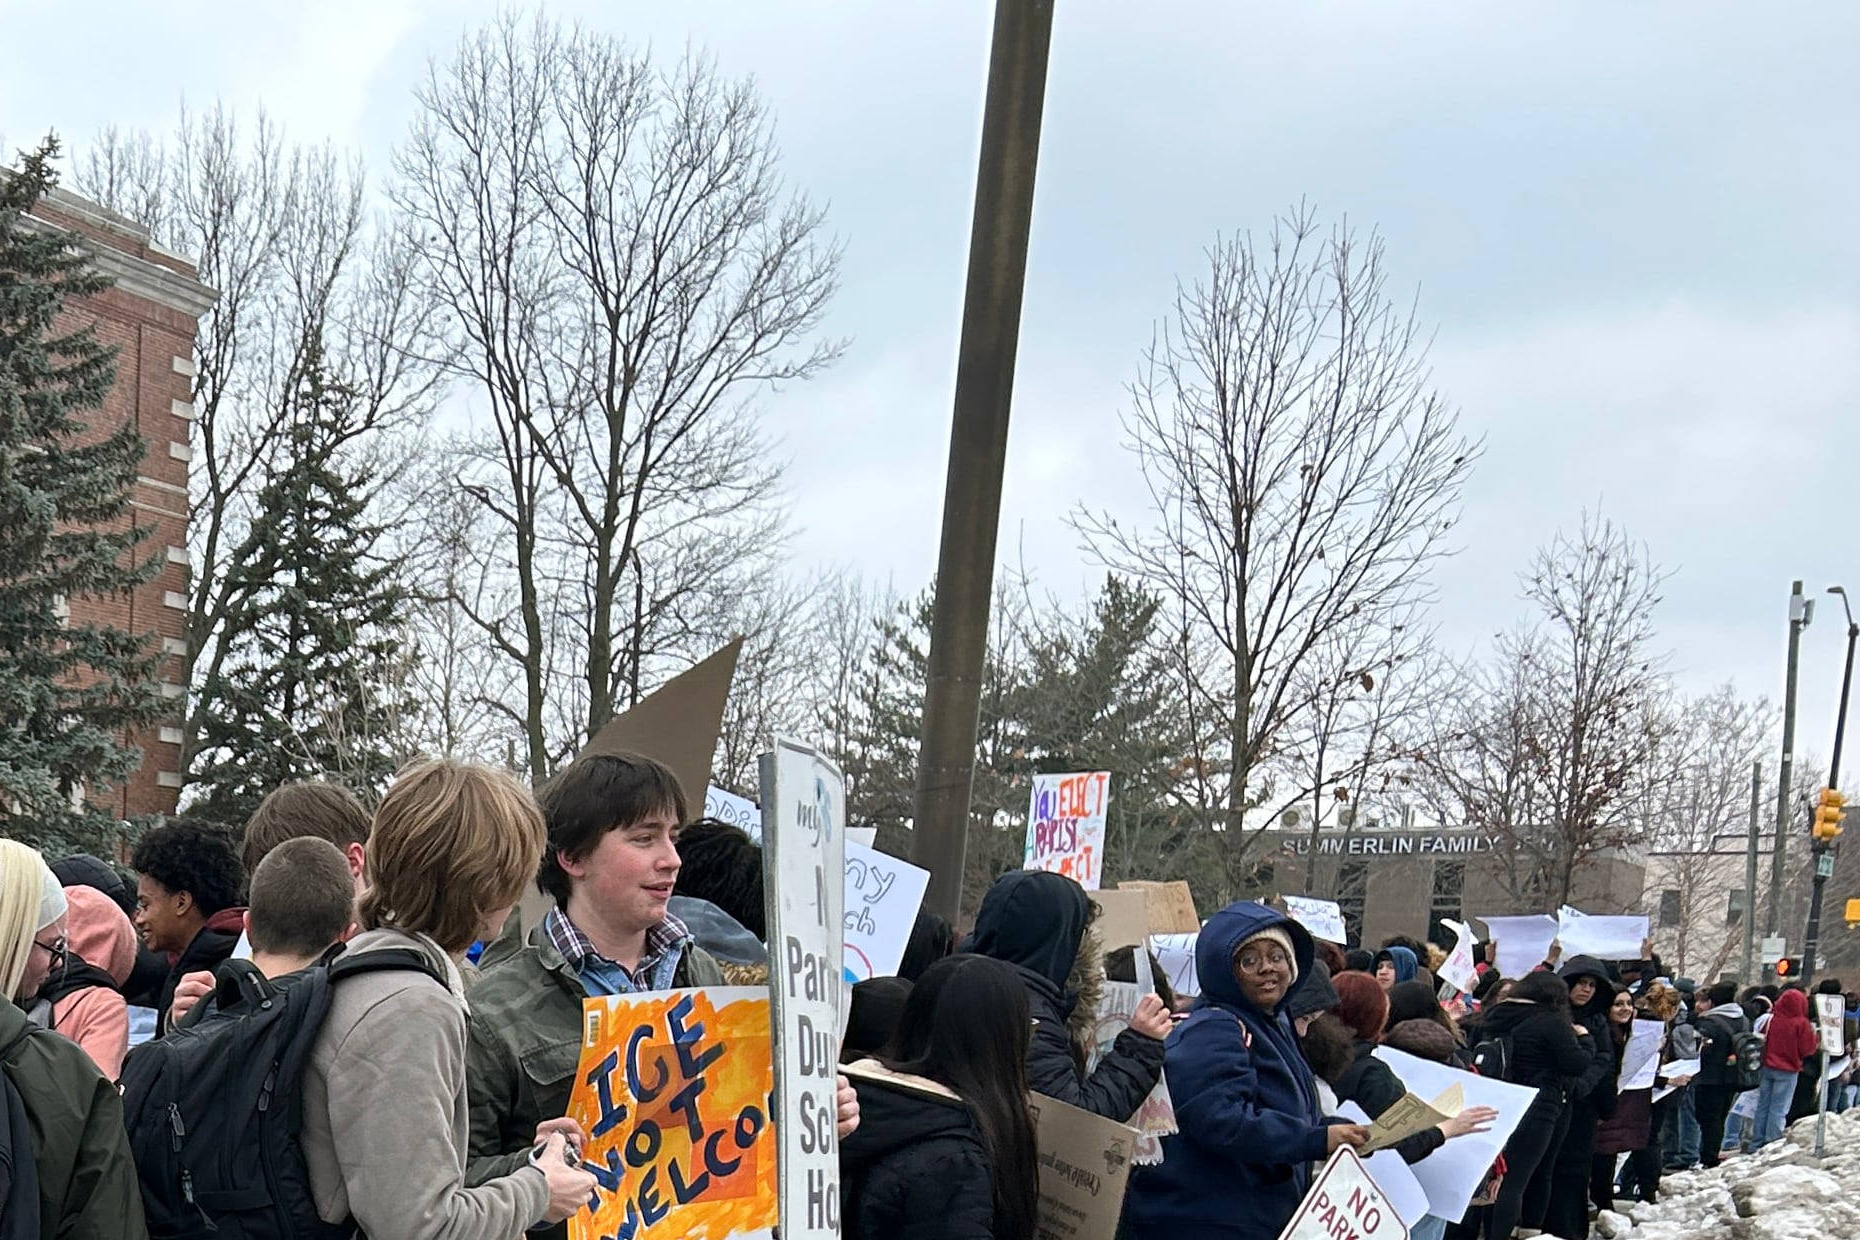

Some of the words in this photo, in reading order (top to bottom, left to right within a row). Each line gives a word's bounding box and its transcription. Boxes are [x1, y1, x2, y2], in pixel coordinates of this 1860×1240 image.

[1059, 772, 1107, 818] ELECT
[1036, 818, 1079, 860] RAPIST
[1283, 836, 1413, 855] SUMMERLIN
[1418, 836, 1501, 853] FAMILY
[586, 994, 727, 1138] ICE
[581, 1076, 706, 1214] NOT
[1346, 1185, 1381, 1235] NO
